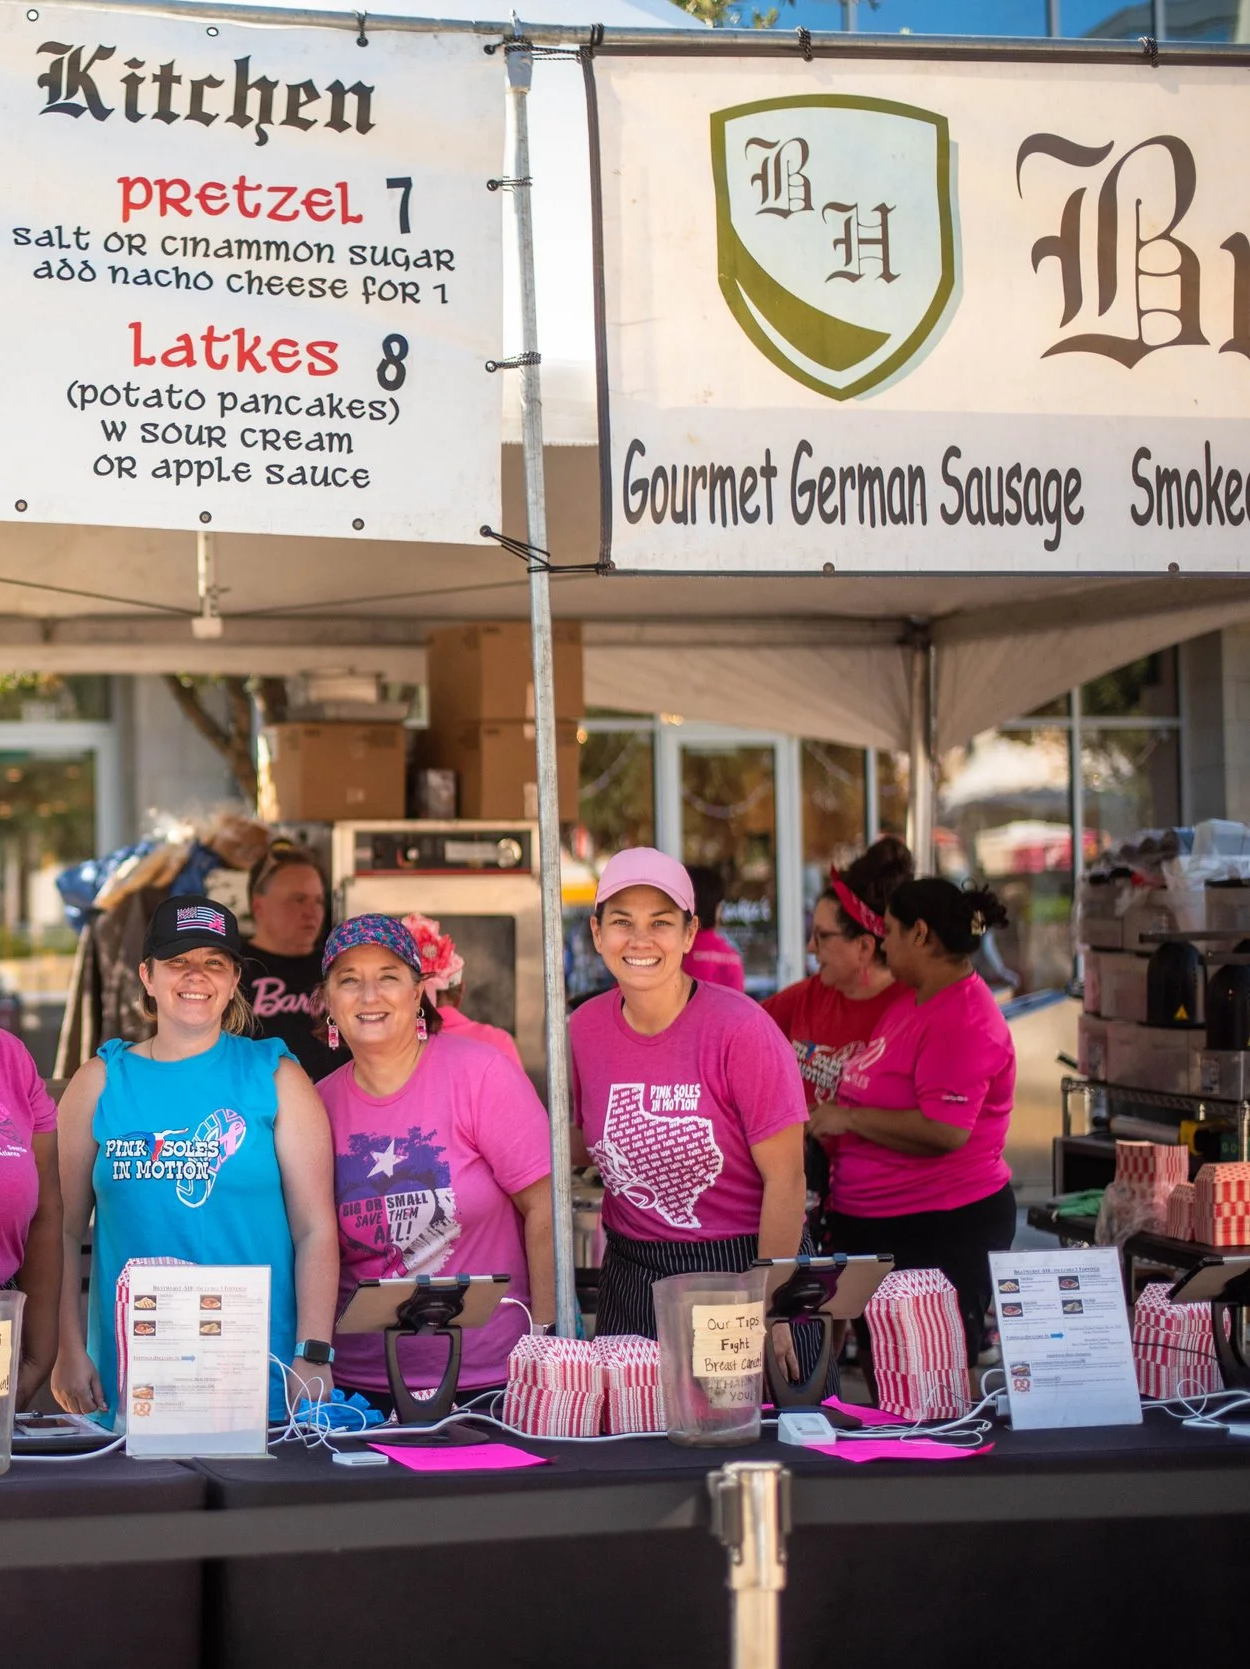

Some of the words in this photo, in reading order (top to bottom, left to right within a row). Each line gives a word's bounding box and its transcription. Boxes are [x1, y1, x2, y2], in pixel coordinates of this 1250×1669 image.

[35, 41, 376, 147] Kitchen
[744, 137, 815, 220] B
[385, 176, 414, 235] 7
[821, 201, 901, 284] H
[376, 332, 410, 392] 8
[622, 438, 778, 529] Gourmet
[790, 439, 928, 529] German
[939, 445, 1085, 552] Sausage
[1130, 439, 1250, 530] Smoke
[650, 1085, 672, 1100] PINK
[673, 1083, 701, 1100] SOLES
[662, 1099, 698, 1111] MOTION
[105, 1139, 148, 1158] PINK
[161, 1141, 220, 1158] SOLES
[112, 1160, 132, 1181] IN
[135, 1160, 211, 1181] MOTION
[386, 1192, 429, 1209] SMALL
[355, 1211, 383, 1228] SAVE
[388, 1206, 419, 1222] THEM
[373, 1221, 413, 1245] ALL!
[707, 1318, 730, 1331] Our
[736, 1316, 760, 1330] Tips
[720, 1338, 750, 1354] Fight
[704, 1357, 737, 1372] Breast
